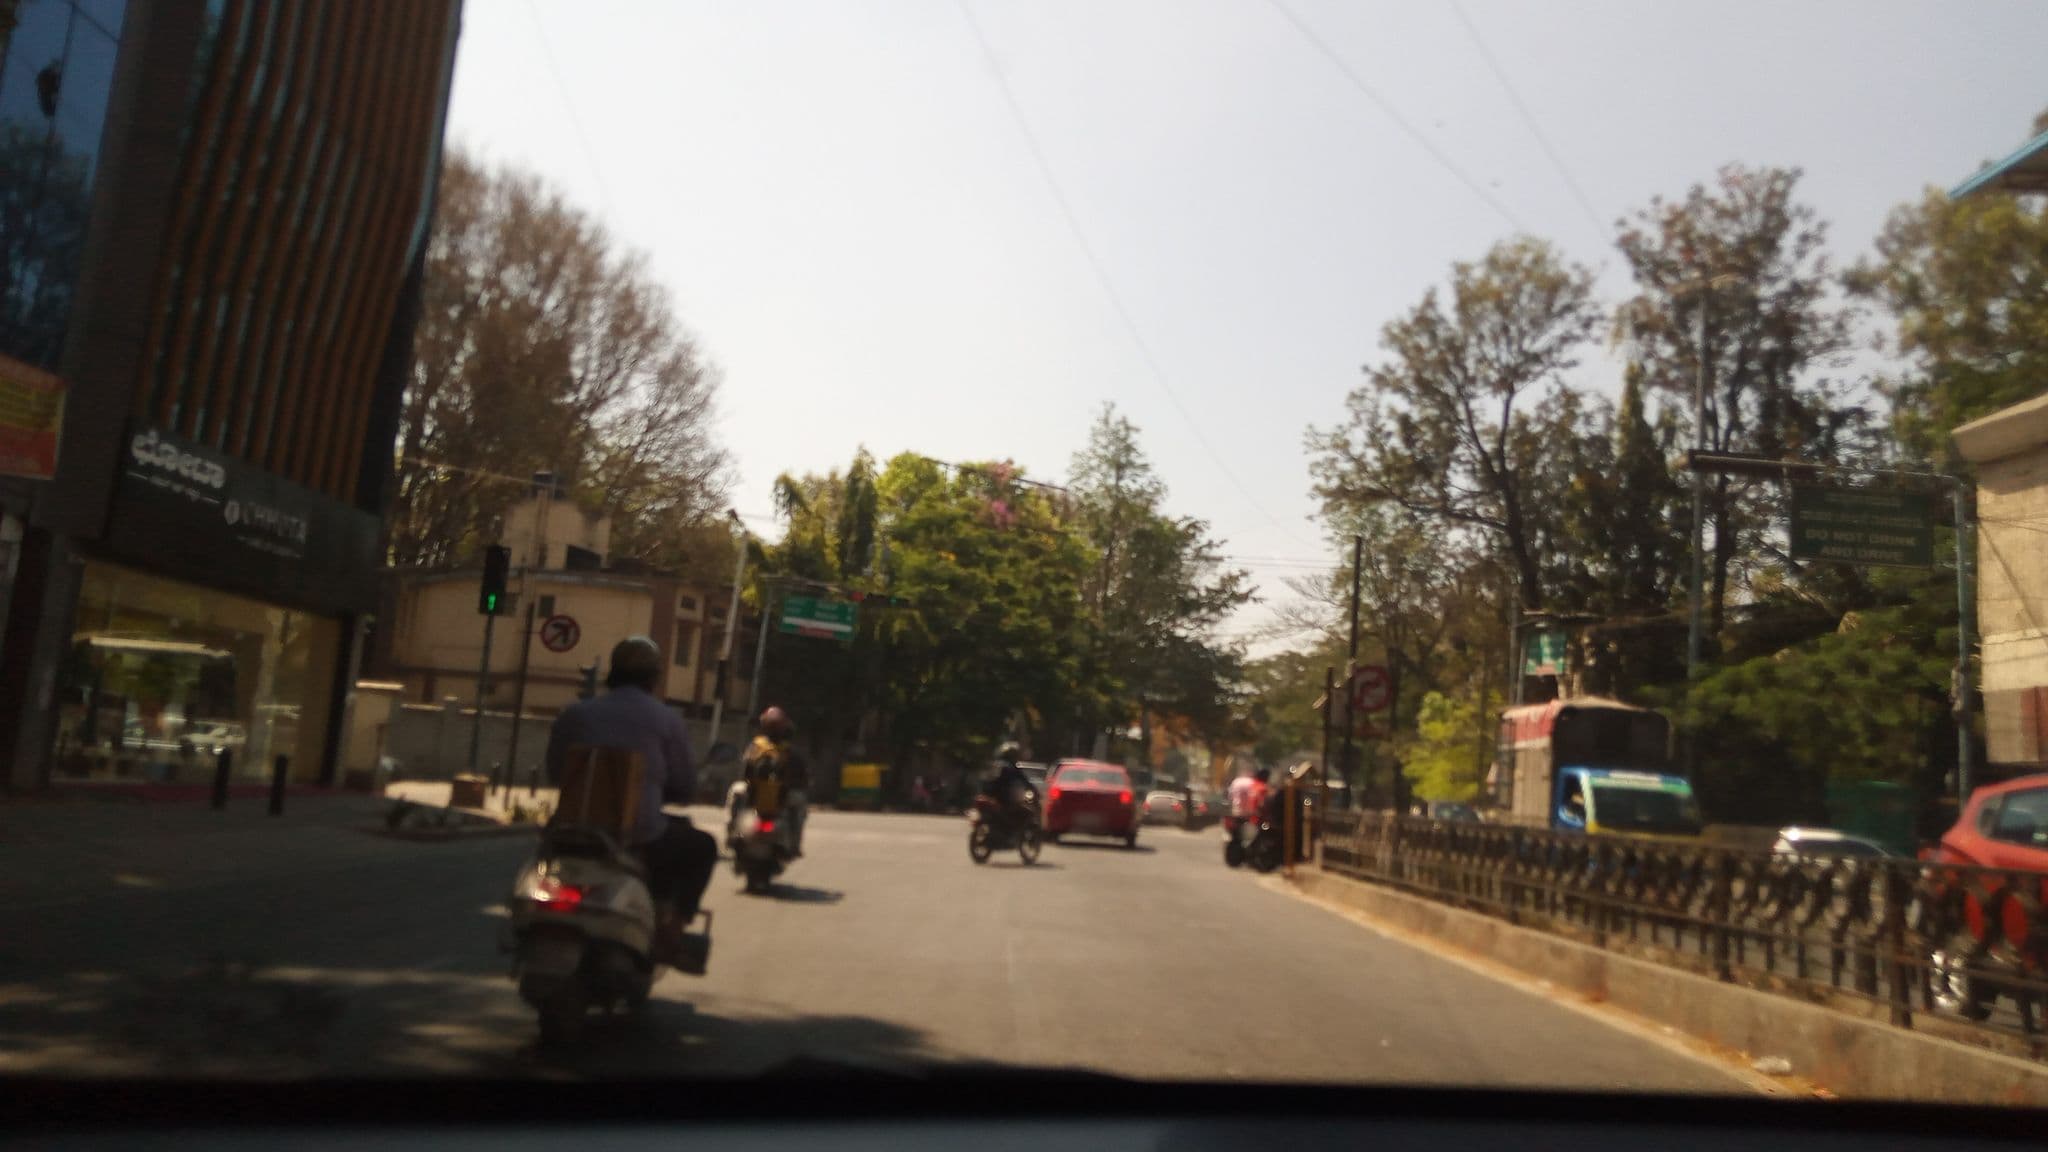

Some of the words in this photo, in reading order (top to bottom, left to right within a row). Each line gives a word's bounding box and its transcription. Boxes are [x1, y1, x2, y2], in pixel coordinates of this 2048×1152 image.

[1806, 528, 1829, 540] DO
[1833, 530, 1863, 543] NOT
[1869, 533, 1916, 546] DRINK
[1821, 546, 1853, 558] AND
[1857, 549, 1904, 562] DRIVE
